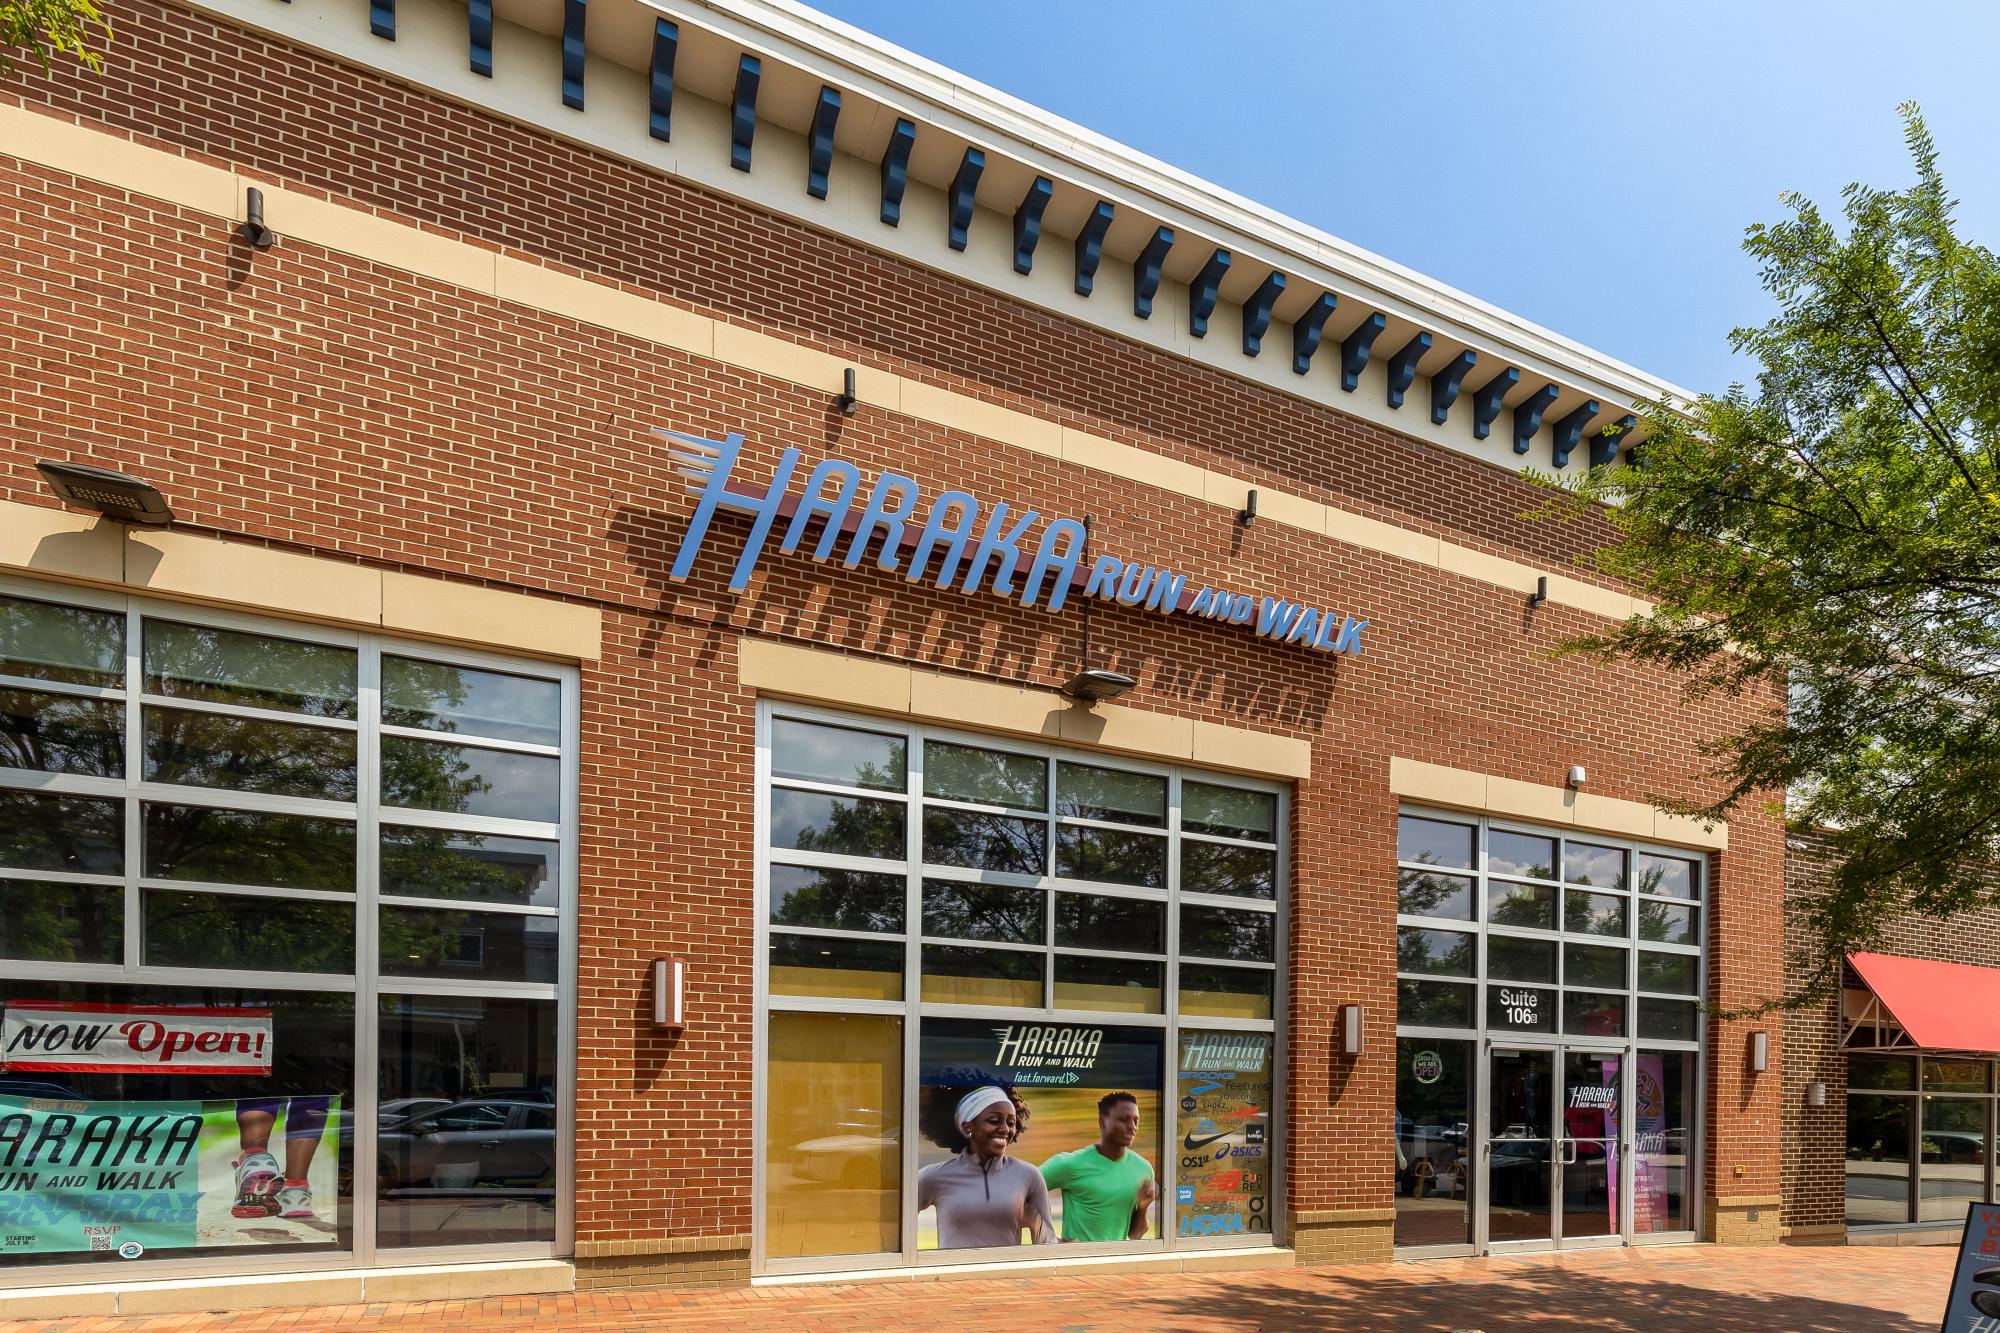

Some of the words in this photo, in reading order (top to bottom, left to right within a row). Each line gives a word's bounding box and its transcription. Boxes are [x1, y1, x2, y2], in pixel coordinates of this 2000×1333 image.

[651, 431, 1086, 613] HARAKA
[1083, 554, 1188, 615] RUN
[1187, 585, 1254, 625] AND
[1256, 595, 1370, 656] WALK
[1500, 988, 1537, 1007] Suite
[9, 1022, 113, 1053] NOW
[119, 1020, 267, 1062] Open!
[991, 1025, 1103, 1066] HARAKA
[1017, 1055, 1044, 1067] RUN
[1045, 1058, 1061, 1066] AND
[1062, 1057, 1096, 1068] WALK
[1182, 1034, 1267, 1069] HARAKA
[1201, 1060, 1221, 1069] RUN
[1236, 1060, 1261, 1070] WALK
[1415, 1066, 1441, 1077] OPEN
[1568, 1086, 1615, 1108] HARAKA
[1231, 1146, 1262, 1157] asics
[46, 1175, 89, 1188] AND
[96, 1171, 184, 1191] WALK
[83, 1225, 122, 1235] RSVP
[1181, 1212, 1244, 1237] HOKA
